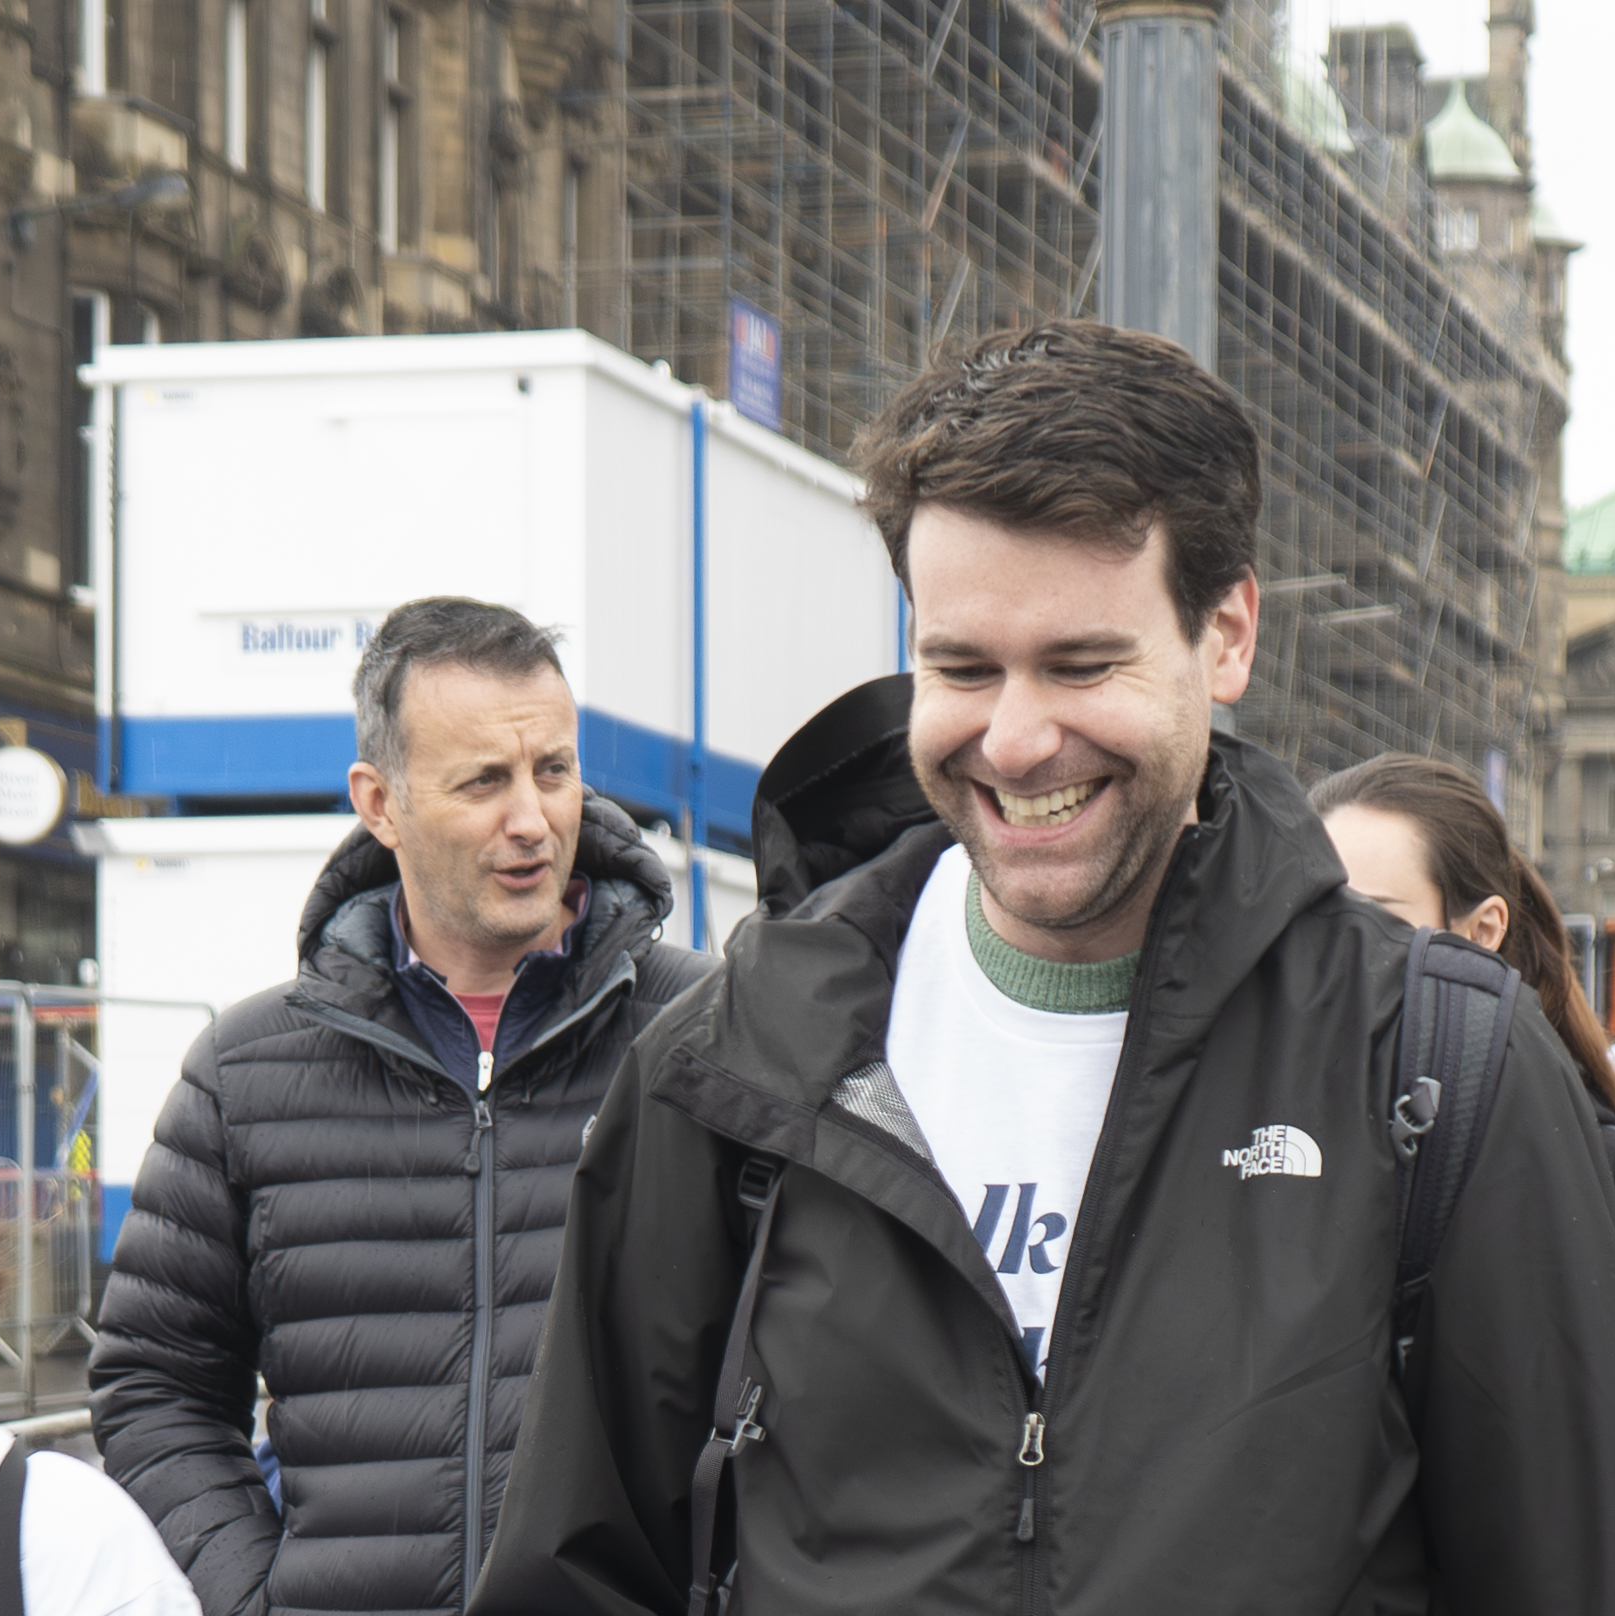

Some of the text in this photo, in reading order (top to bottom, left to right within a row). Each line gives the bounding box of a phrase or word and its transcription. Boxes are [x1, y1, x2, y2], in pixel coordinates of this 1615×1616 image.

[241, 620, 341, 651] Balfour
[1252, 1124, 1286, 1146] THE
[1223, 1141, 1285, 1167] NORTH
[1240, 1155, 1284, 1180] FACE
[972, 1182, 1068, 1275] lk
